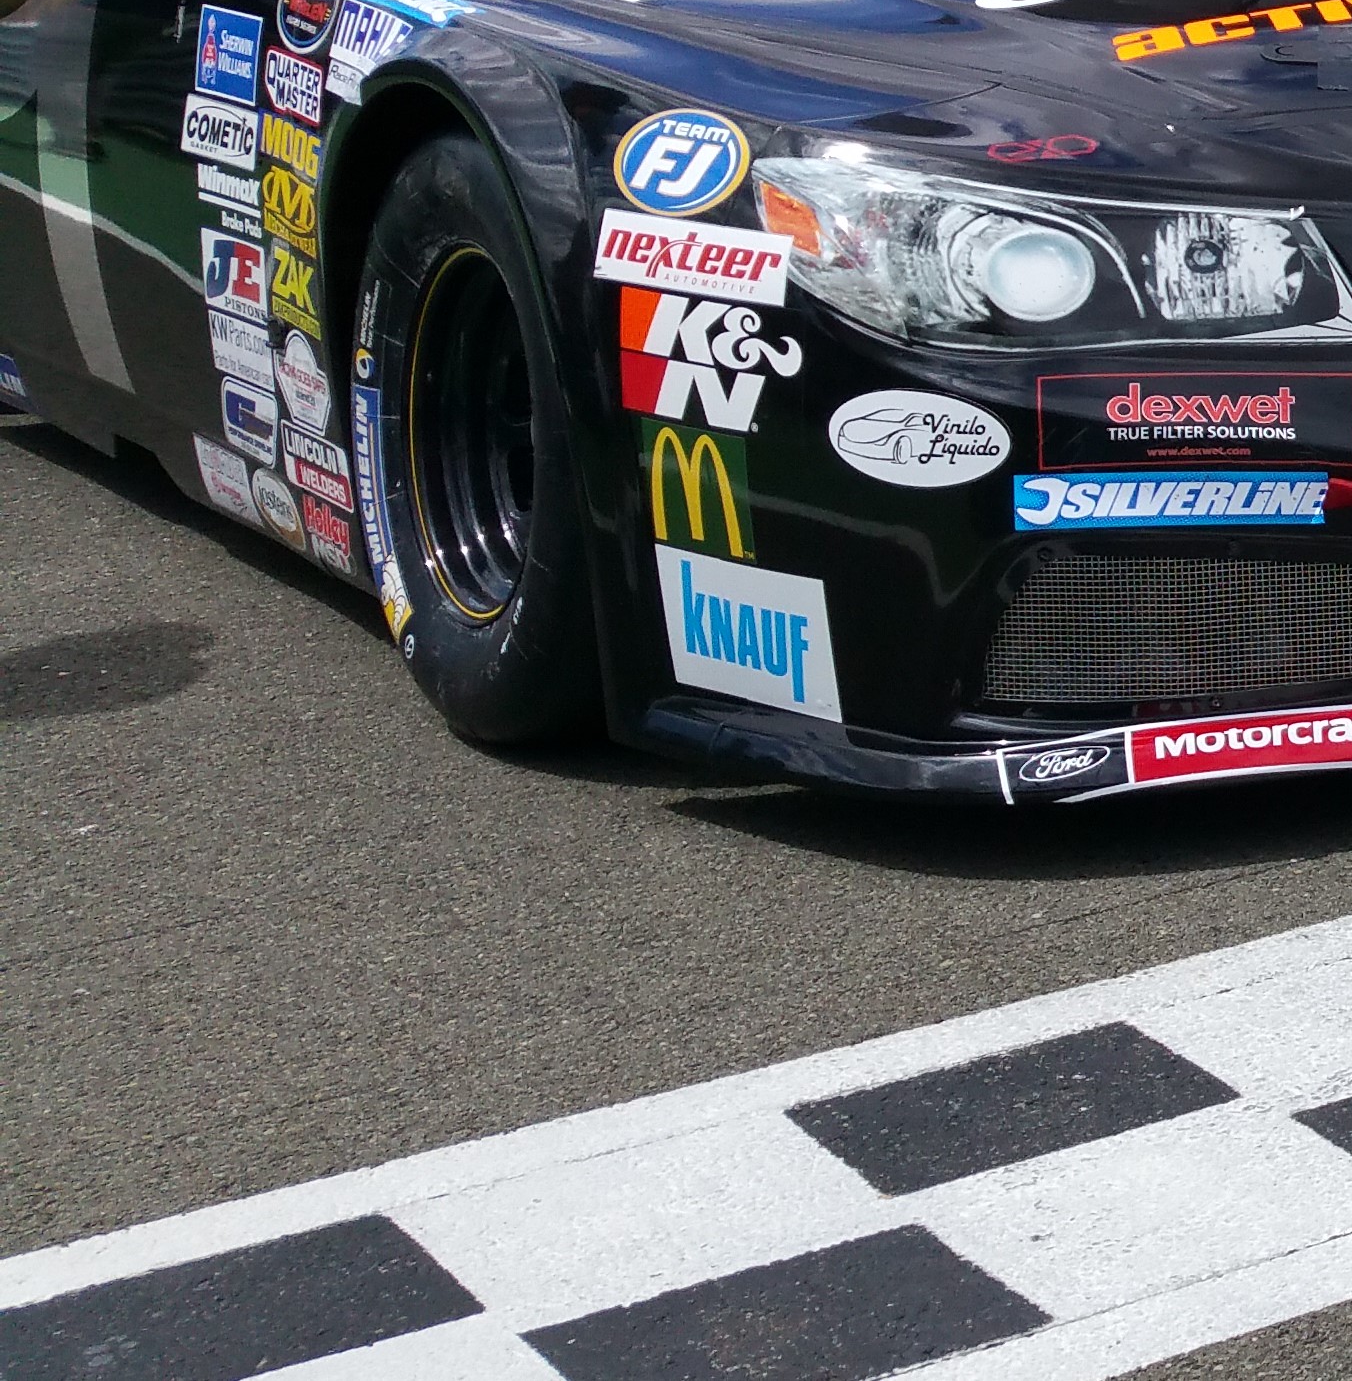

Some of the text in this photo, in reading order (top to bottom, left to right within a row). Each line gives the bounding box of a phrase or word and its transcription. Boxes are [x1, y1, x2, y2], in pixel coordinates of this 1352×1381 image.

[268, 52, 320, 96] QUARTER
[276, 78, 320, 123] MASTER
[187, 110, 254, 156] COMETIC
[189, 140, 218, 154] GASKET
[261, 113, 322, 180] MOOG
[661, 118, 732, 143] TEAM
[629, 136, 725, 197] FJ
[206, 239, 261, 304] JE
[601, 227, 782, 283] nexteer
[271, 245, 317, 316] ZAK
[664, 272, 756, 294] AUTOMOTIVE
[224, 296, 267, 321] PISTONS
[922, 413, 986, 436] Vinilo
[1105, 382, 1296, 424] dexwet
[284, 427, 338, 474] LINCOLN
[918, 433, 1001, 465] Líquido
[1107, 424, 1296, 441] TRUE FILTER SOLUTIONS
[1146, 446, 1251, 457] www.dexwet.com
[301, 465, 347, 504] WELDERS
[353, 393, 384, 565] MICHELIN
[303, 493, 350, 557] Holley
[680, 558, 809, 705] KNAUF
[1034, 747, 1094, 778] Ford
